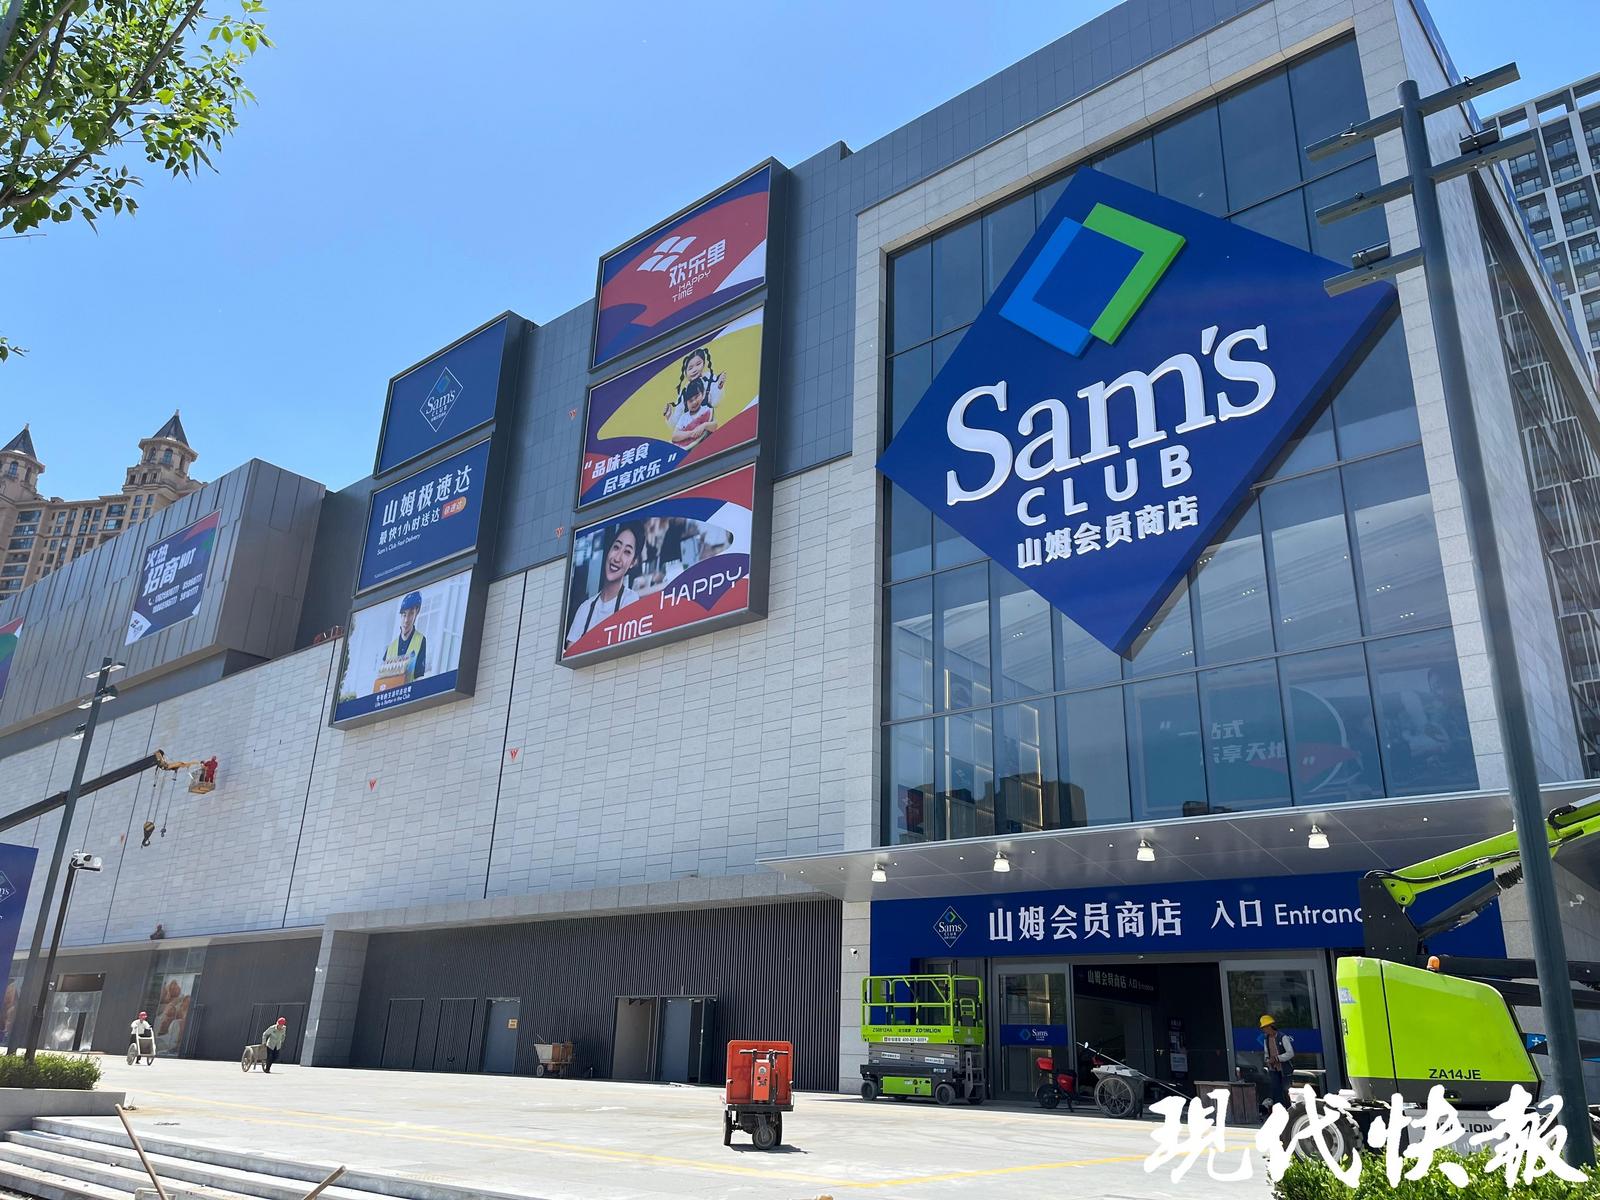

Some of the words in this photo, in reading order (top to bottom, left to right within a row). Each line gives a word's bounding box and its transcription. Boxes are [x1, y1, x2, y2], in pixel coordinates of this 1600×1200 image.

[669, 239, 726, 288] 欢乐里
[679, 269, 711, 292] HAPPY
[672, 286, 693, 302] TIME
[947, 324, 1276, 506] Sam's
[382, 464, 473, 527] 山姆极速达
[1016, 444, 1194, 527] CLUB
[379, 508, 440, 545] 最快1小时送达
[1016, 495, 1199, 569] 山姆会员商店
[142, 556, 180, 597] 招商
[659, 566, 743, 610] HAPPY
[603, 614, 654, 645] TIME
[988, 899, 1183, 942] 山姆会员商店
[1210, 899, 1263, 929] 入口
[1274, 902, 1363, 926] Entranc
[1428, 1068, 1482, 1080] ZA14JE
